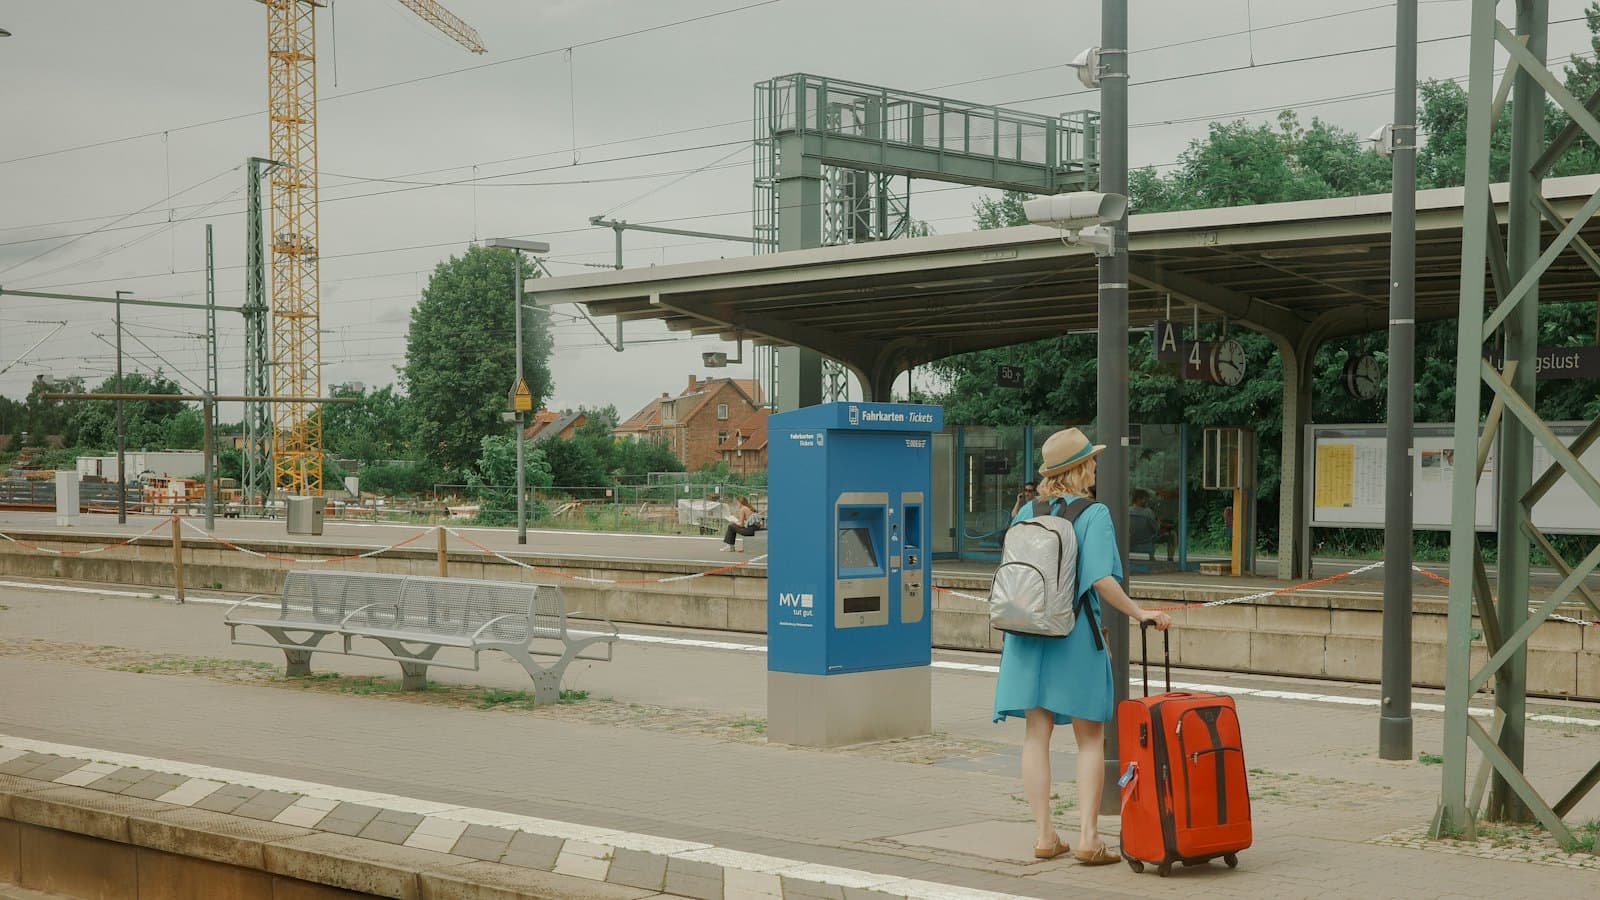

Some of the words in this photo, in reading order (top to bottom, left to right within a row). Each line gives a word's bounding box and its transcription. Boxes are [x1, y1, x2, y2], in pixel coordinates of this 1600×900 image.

[1161, 323, 1176, 352] A
[1189, 341, 1201, 371] 4
[862, 410, 904, 423] Fahrkarten
[909, 412, 933, 424] Tickets
[779, 592, 801, 607] MV
